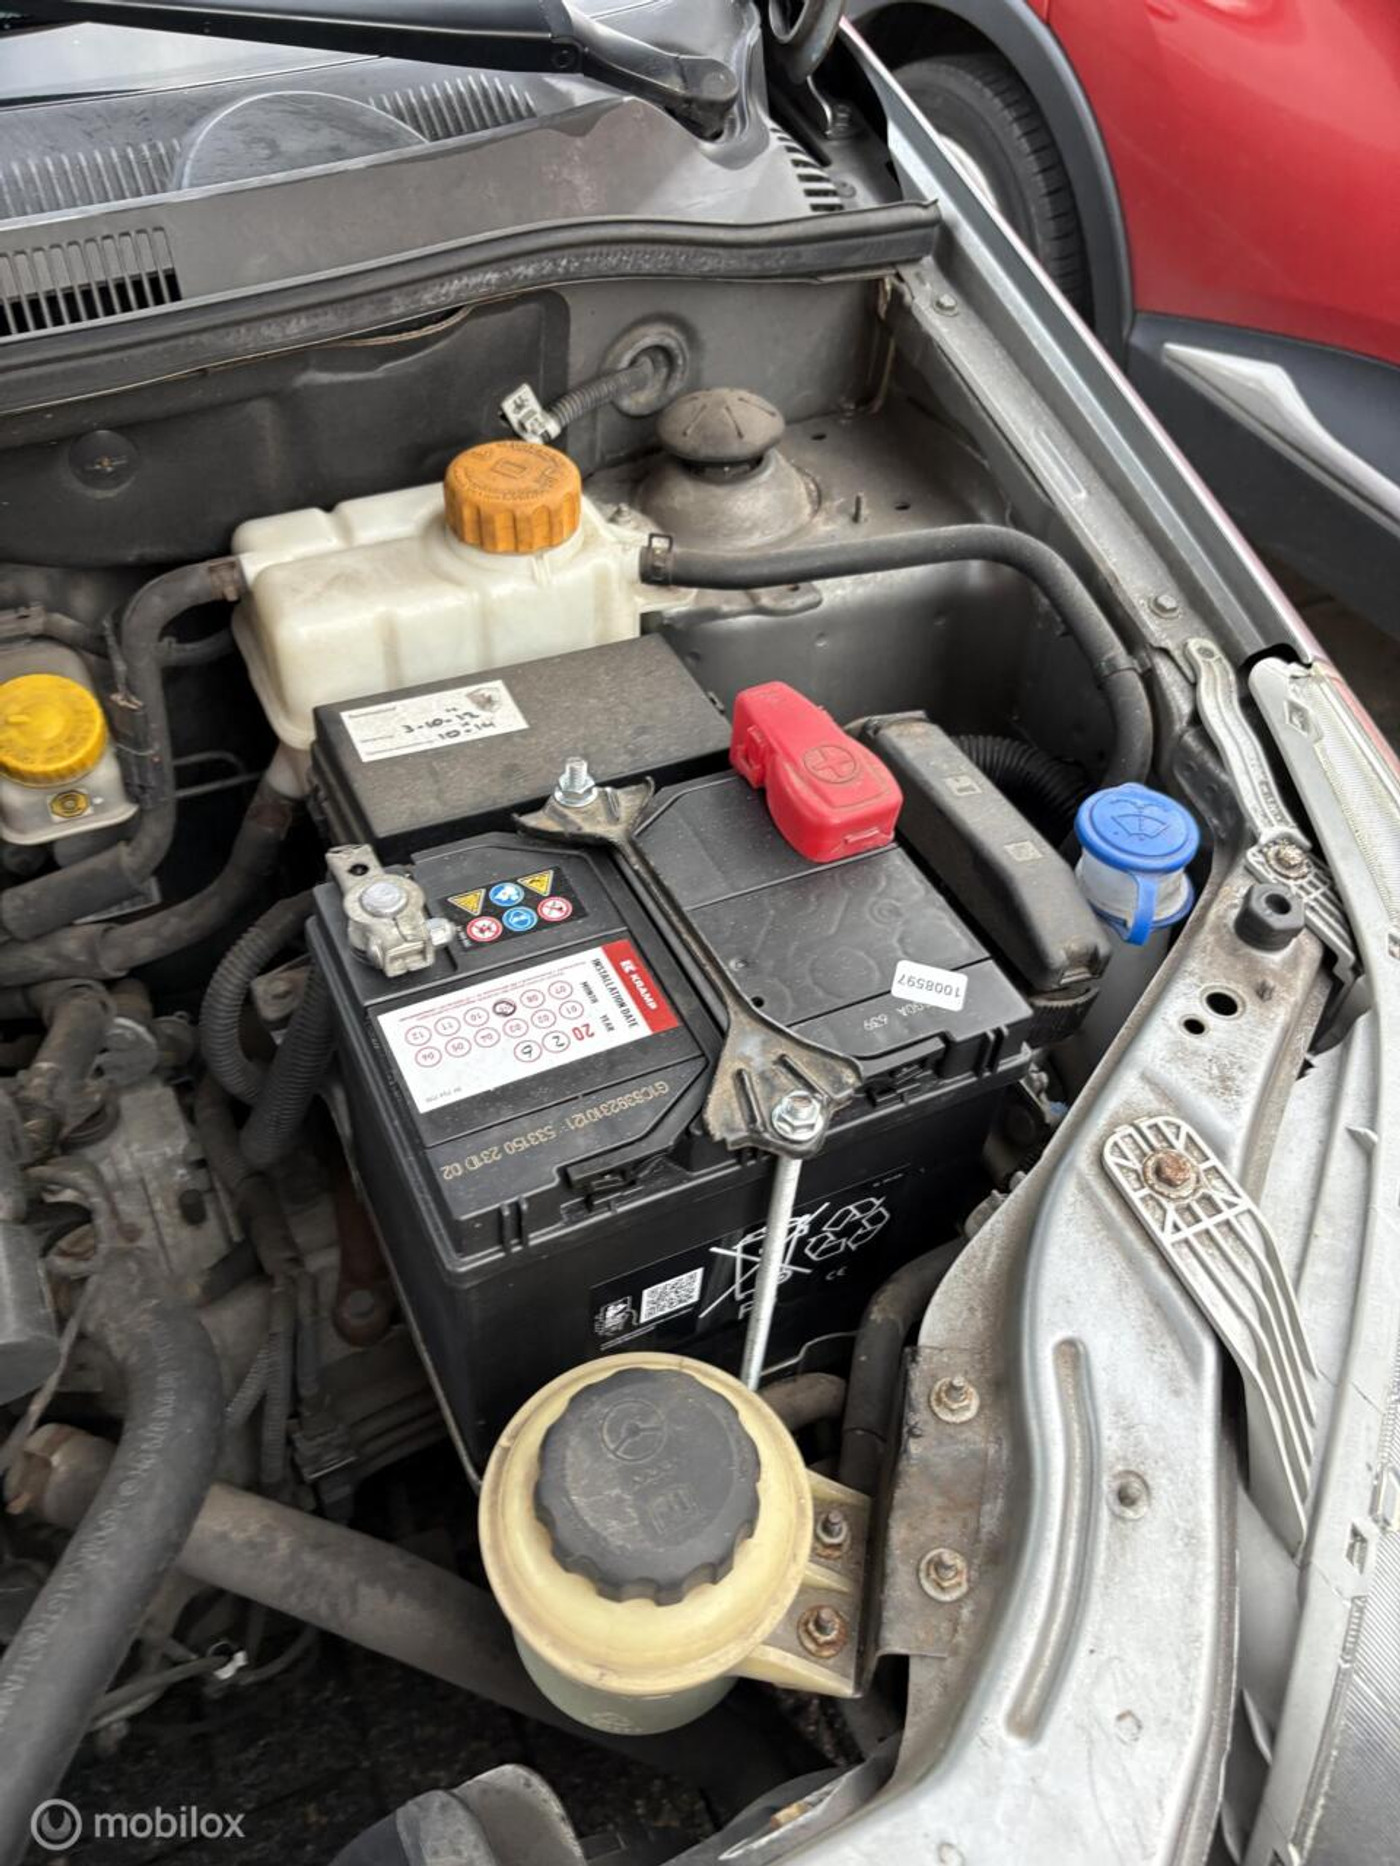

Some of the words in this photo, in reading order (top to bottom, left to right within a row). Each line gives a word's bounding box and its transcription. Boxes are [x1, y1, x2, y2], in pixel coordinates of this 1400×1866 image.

[591, 957, 627, 1009] INSTALLATION
[620, 1006, 640, 1028] DATE
[629, 973, 659, 1010] KRAMP
[898, 973, 961, 998] 1008597
[572, 1023, 595, 1041] 20
[600, 1014, 616, 1032] YEAR
